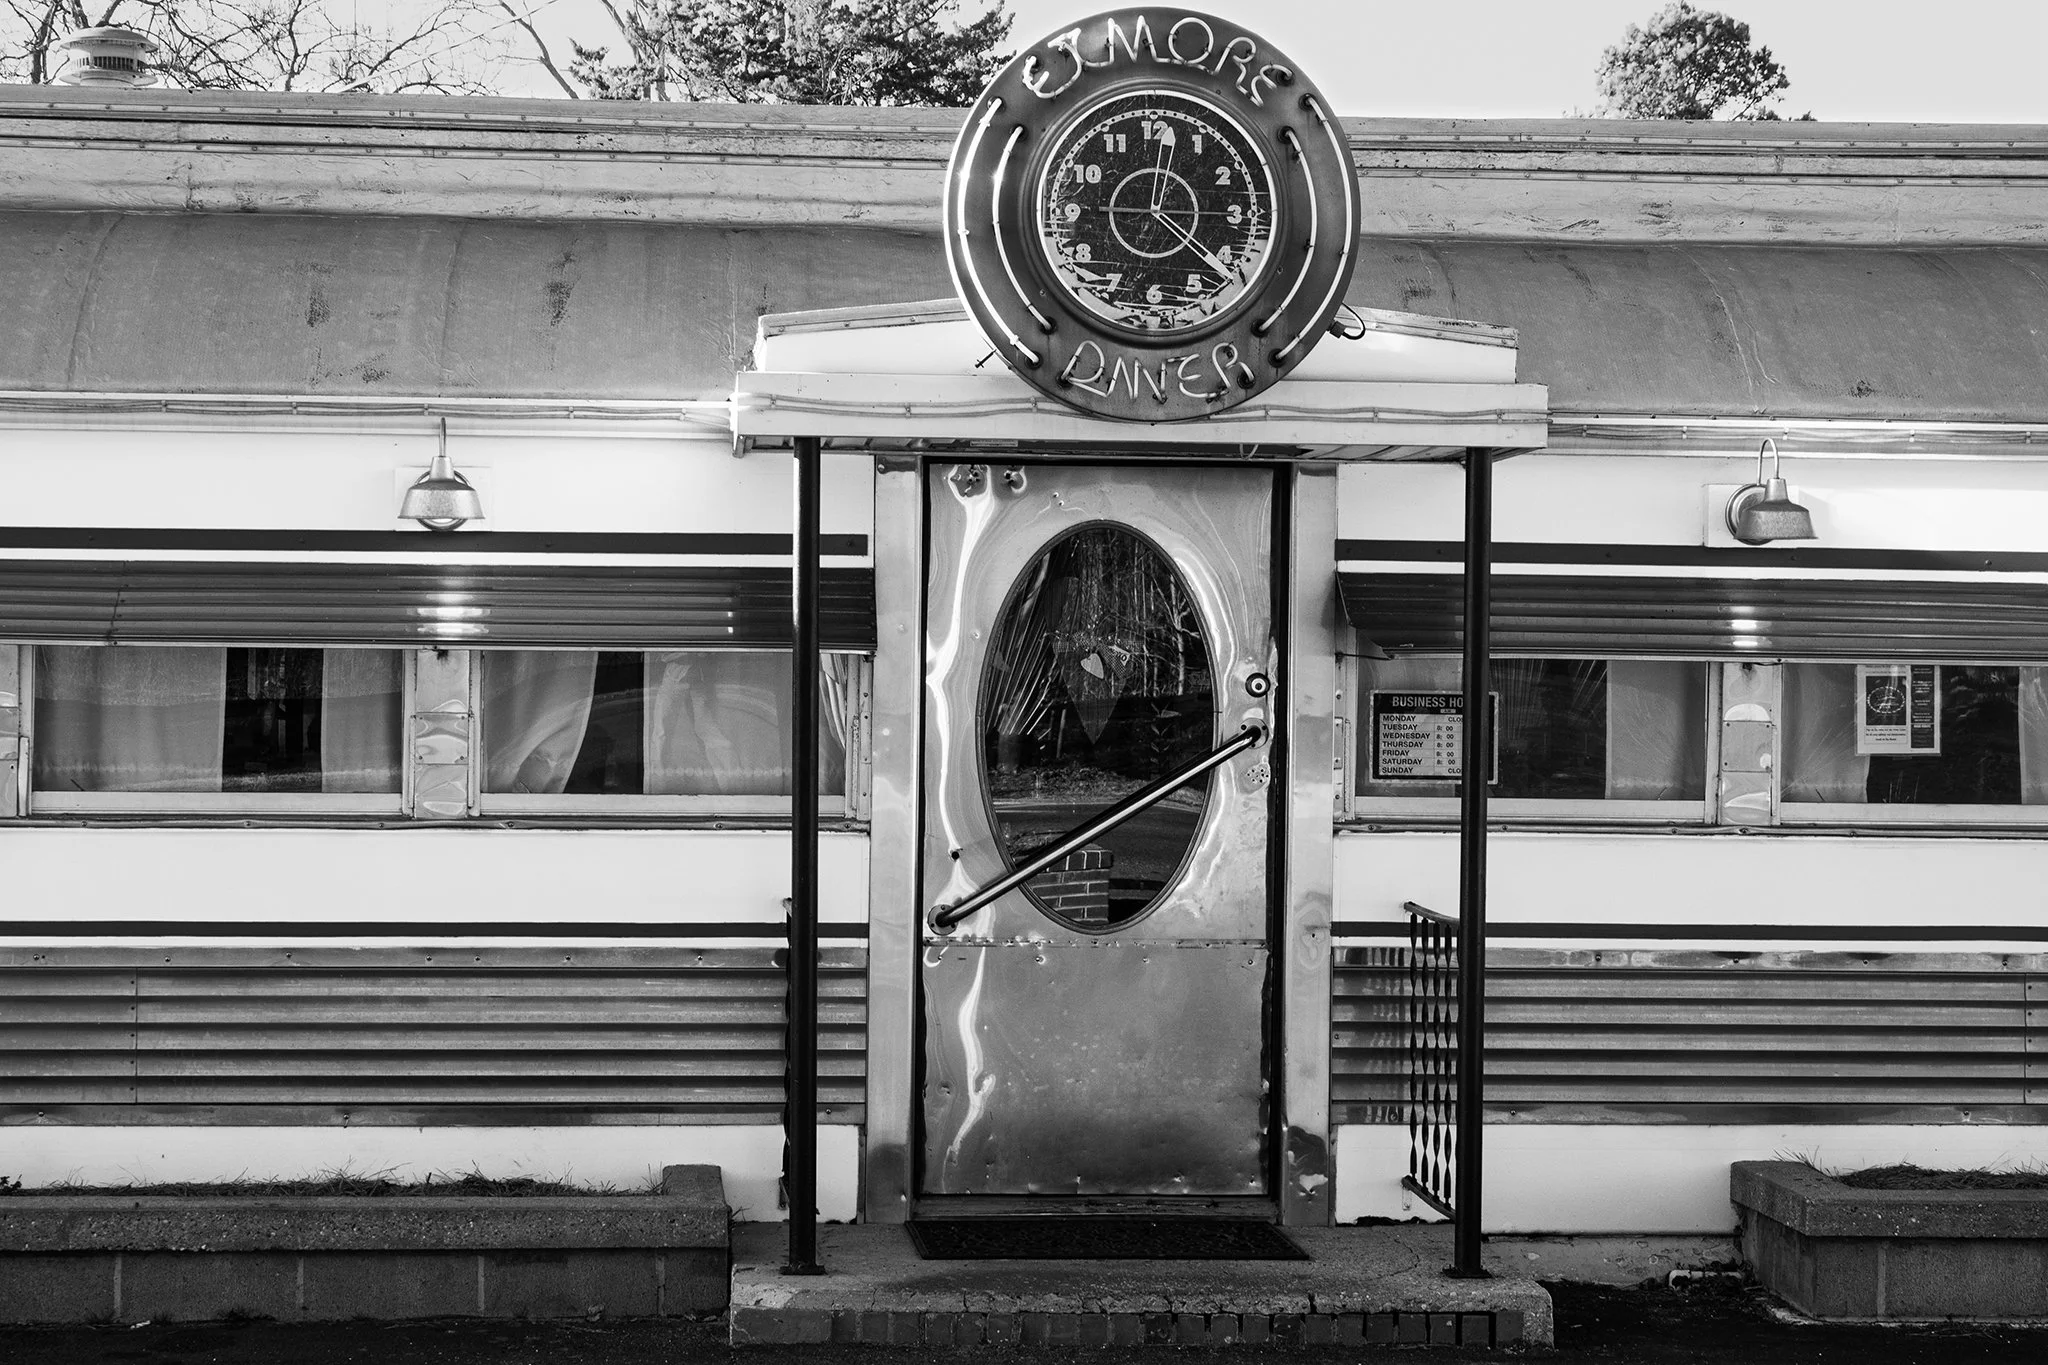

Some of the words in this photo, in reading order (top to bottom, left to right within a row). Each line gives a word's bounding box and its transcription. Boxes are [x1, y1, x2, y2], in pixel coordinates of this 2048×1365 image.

[1142, 121, 1169, 140] 12
[1103, 134, 1127, 153] 11
[1191, 135, 1203, 154] 1
[1073, 164, 1101, 184] 10
[1215, 166, 1231, 186] 2
[1064, 203, 1081, 223] 9
[1226, 204, 1243, 224] 3
[1075, 243, 1091, 262] 8
[1216, 245, 1232, 264] 4
[1105, 273, 1122, 292] 7
[1186, 274, 1202, 294] 5
[1146, 285, 1163, 304] 6
[1060, 340, 1255, 403] DINER
[1392, 696, 1446, 708] BUSINESS
[1449, 697, 1463, 708] HO
[1382, 723, 1418, 731] TUESDAY
[1382, 732, 1430, 740] WEDNESDAY
